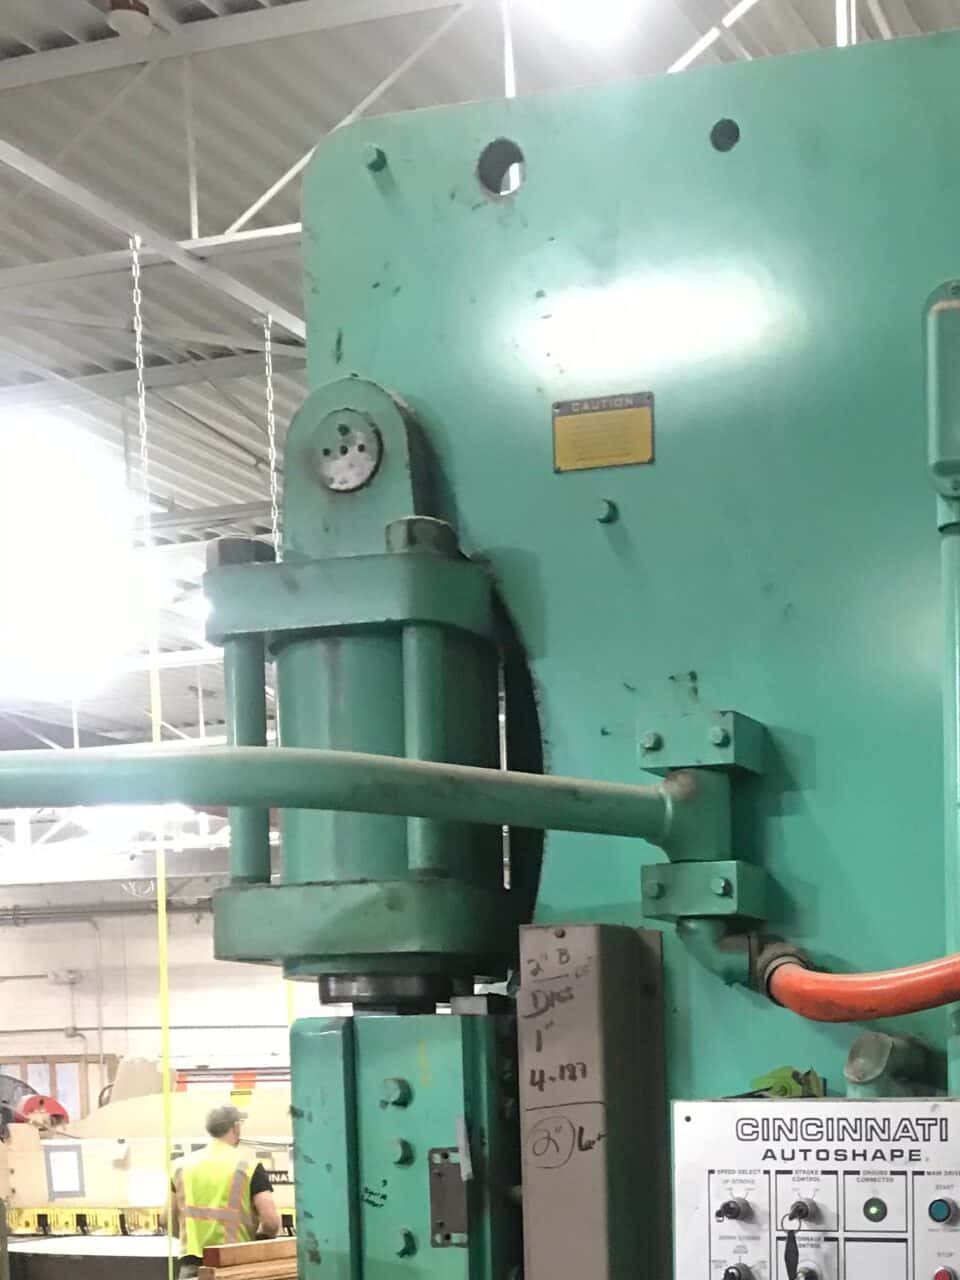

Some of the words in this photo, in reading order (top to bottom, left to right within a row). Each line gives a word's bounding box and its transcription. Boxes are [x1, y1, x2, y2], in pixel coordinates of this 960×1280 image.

[570, 397, 635, 412] CAUTION
[735, 1117, 949, 1142] CINCINNATI
[761, 1148, 922, 1162] AUTOSHAPE
